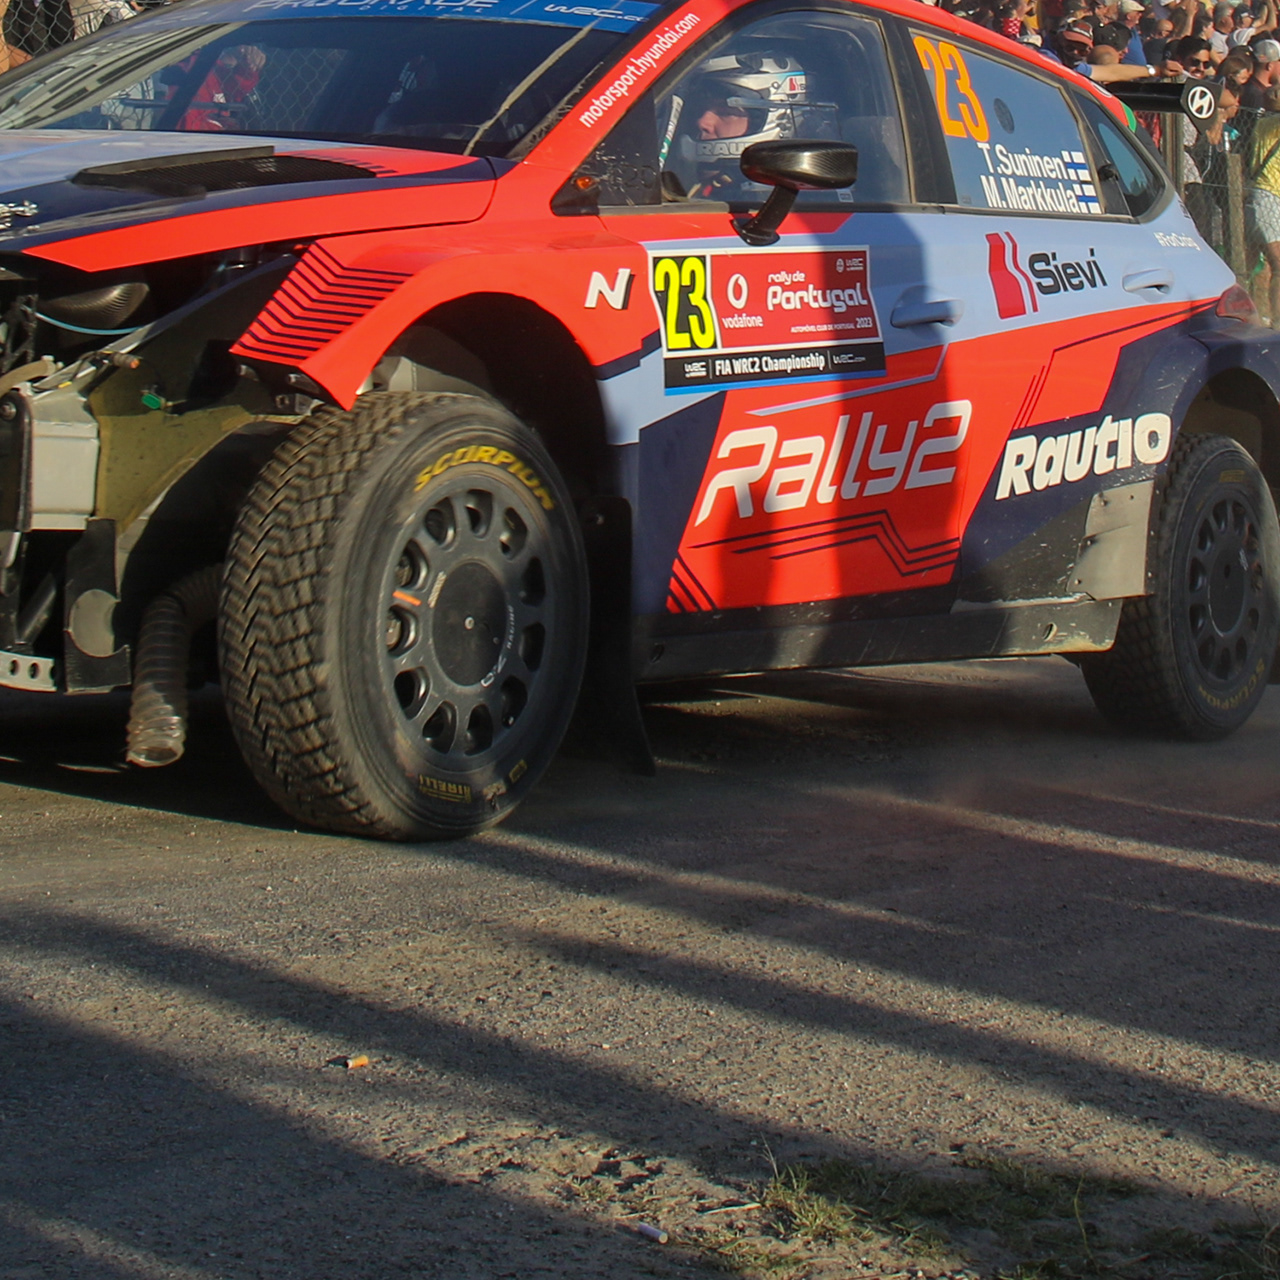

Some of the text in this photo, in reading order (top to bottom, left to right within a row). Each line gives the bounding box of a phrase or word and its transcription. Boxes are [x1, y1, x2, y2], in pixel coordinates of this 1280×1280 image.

[359, 5, 483, 13] DIGITAL
[579, 12, 701, 128] motorsport.hyundai.com
[913, 36, 989, 142] 23
[976, 142, 1068, 180] T.Suninen
[980, 175, 1080, 213] M.Markkula
[768, 271, 805, 286] rally de
[1028, 248, 1108, 295] Sievi
[654, 257, 716, 350] 23
[767, 282, 868, 313] Portugal
[722, 313, 764, 329] vodafone
[856, 317, 874, 329] 2023
[715, 352, 826, 376] FIA WRC2 Championship
[694, 399, 973, 527] Rally2
